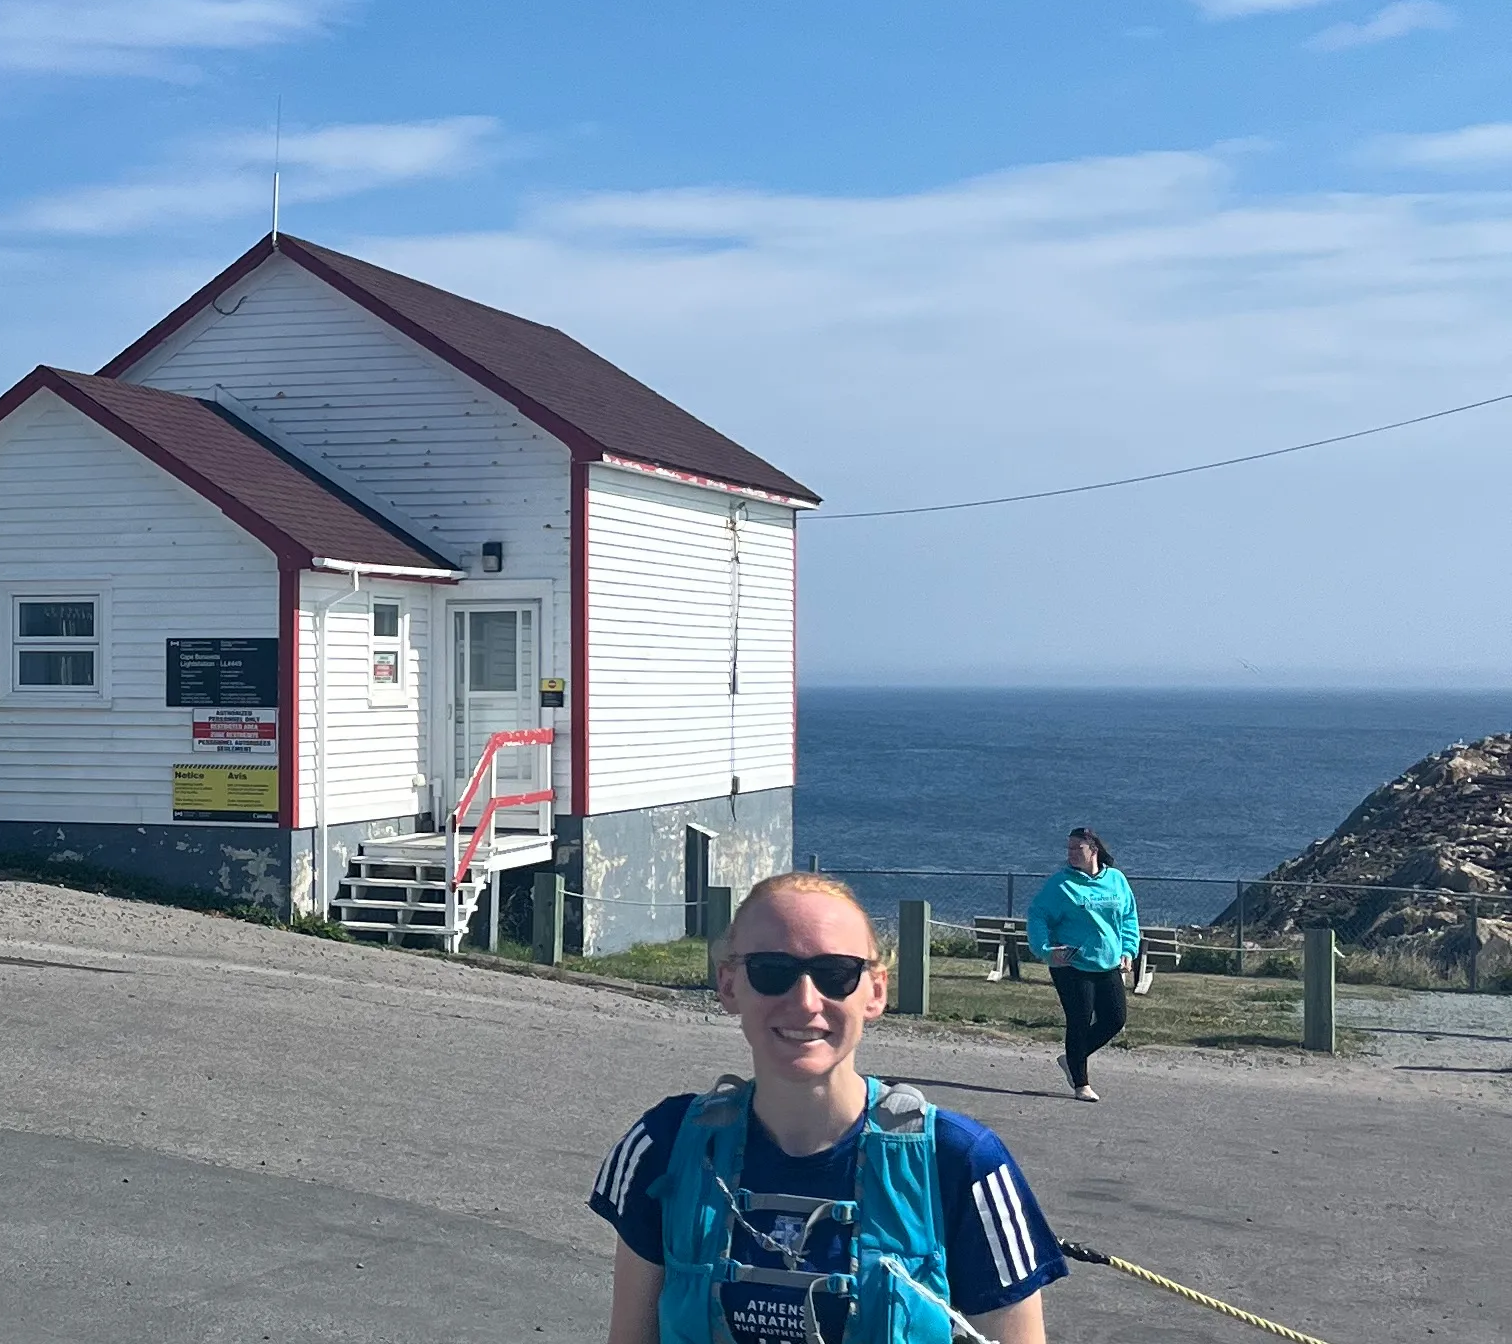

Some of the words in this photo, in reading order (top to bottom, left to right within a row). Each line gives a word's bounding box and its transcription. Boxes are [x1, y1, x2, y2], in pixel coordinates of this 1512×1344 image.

[175, 771, 205, 779] Notice
[228, 772, 248, 780] Avis
[747, 1300, 805, 1316] ATHENS
[733, 1311, 807, 1330] MARATHO
[734, 1324, 756, 1332] THE
[760, 1327, 806, 1338] AUTHEN
